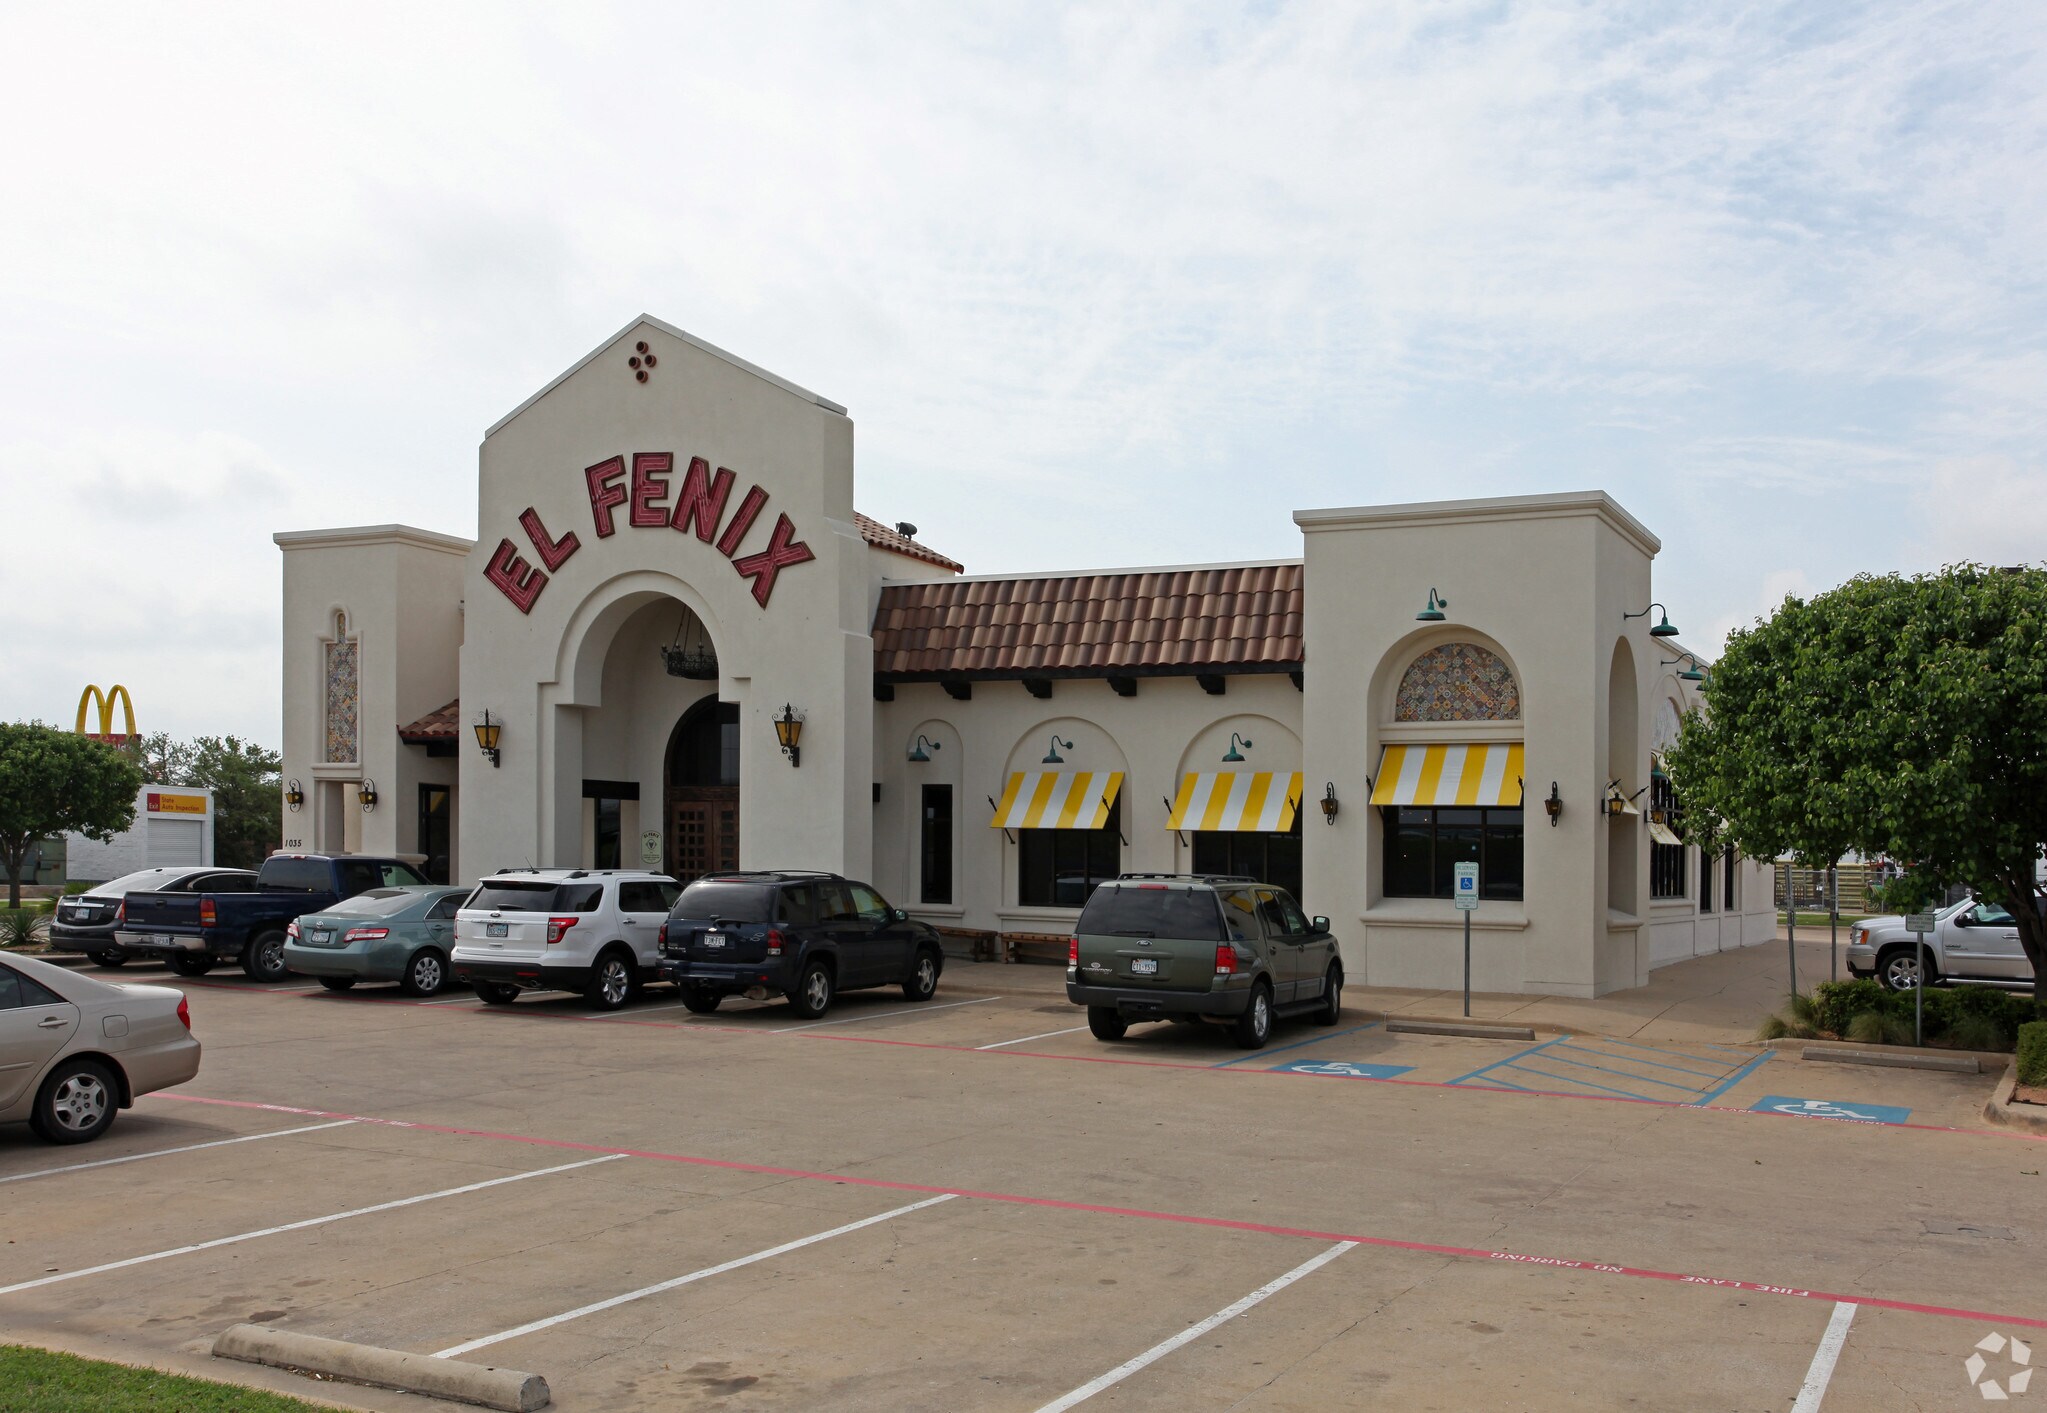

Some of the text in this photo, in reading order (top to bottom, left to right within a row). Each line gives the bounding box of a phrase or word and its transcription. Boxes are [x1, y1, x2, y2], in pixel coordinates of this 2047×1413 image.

[483, 451, 816, 616] EL FENIX
[285, 839, 302, 848] 1035
[1489, 1252, 1810, 1297] FIRE LANE NO PARKING
